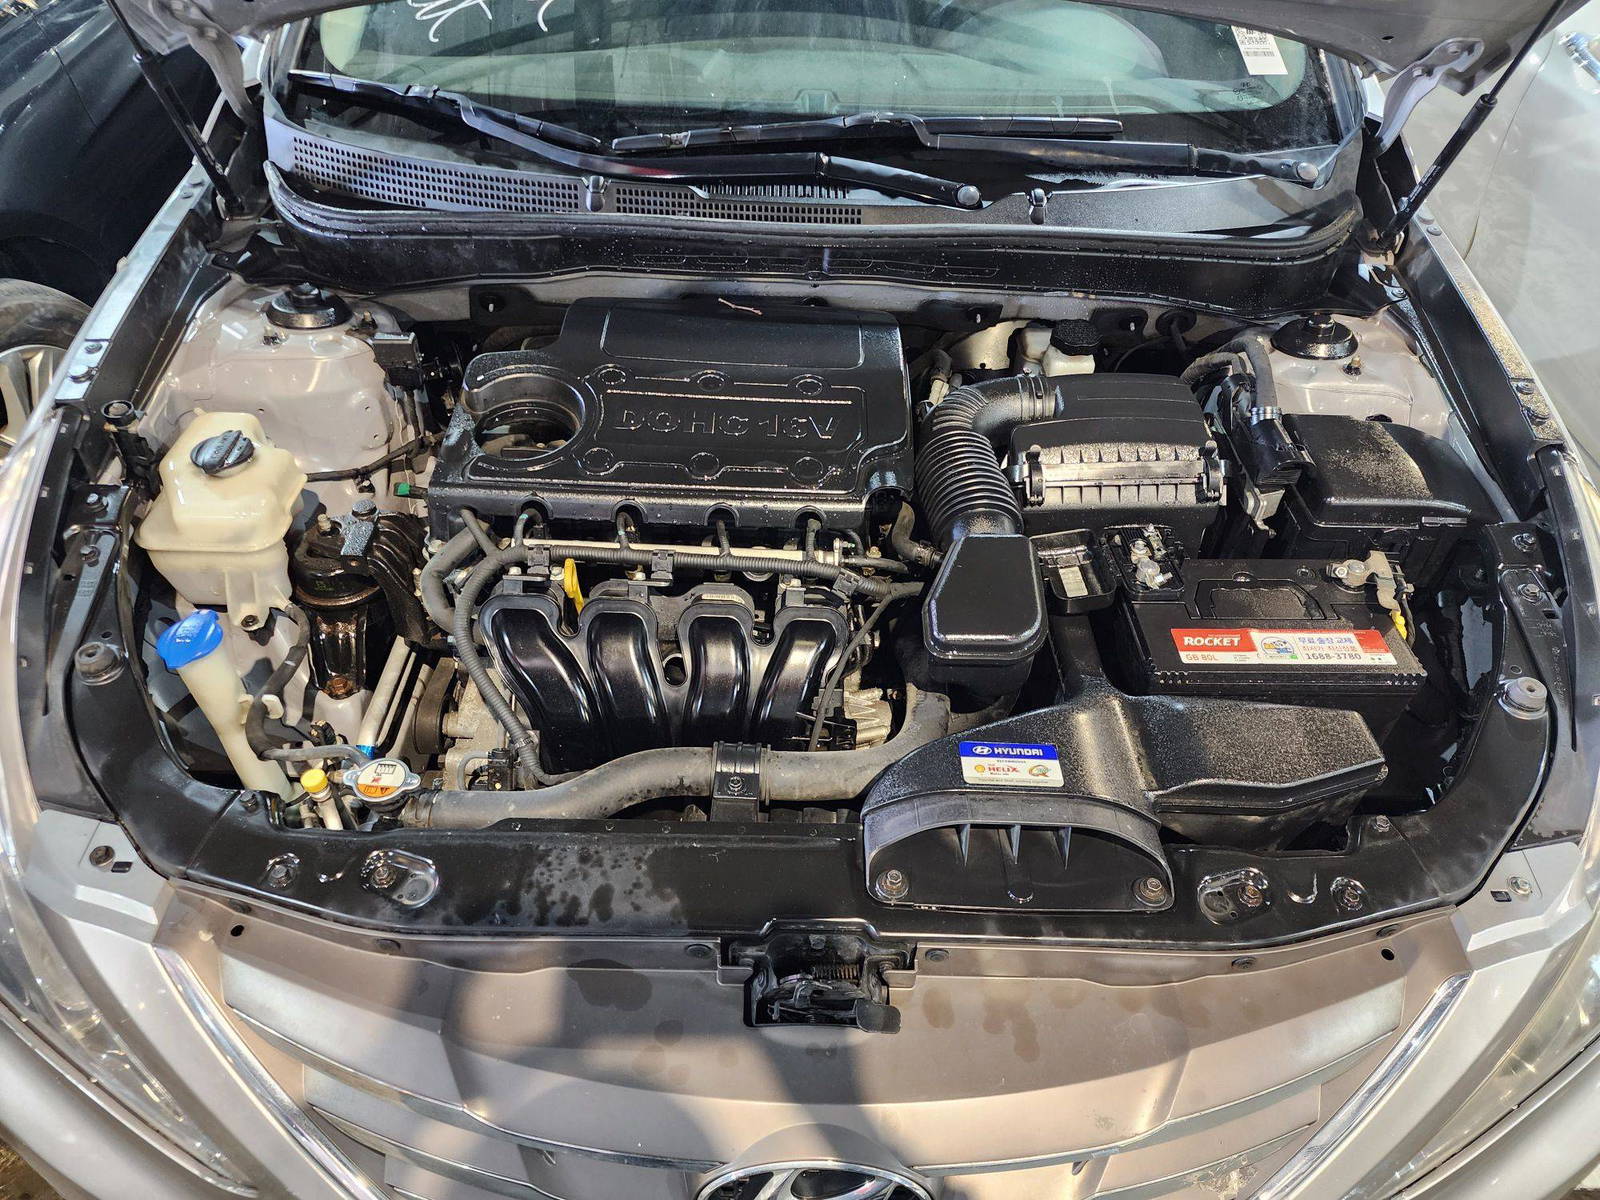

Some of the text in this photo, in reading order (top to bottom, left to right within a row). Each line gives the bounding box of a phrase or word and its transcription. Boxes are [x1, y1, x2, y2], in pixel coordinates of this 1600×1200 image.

[612, 409, 749, 437] DOHC
[1183, 636, 1241, 647] ROCKET
[1185, 653, 1199, 661] GB
[1305, 652, 1362, 660] 1688-3780
[994, 747, 1043, 756] HYUNDAI
[987, 765, 1018, 773] HELIX
